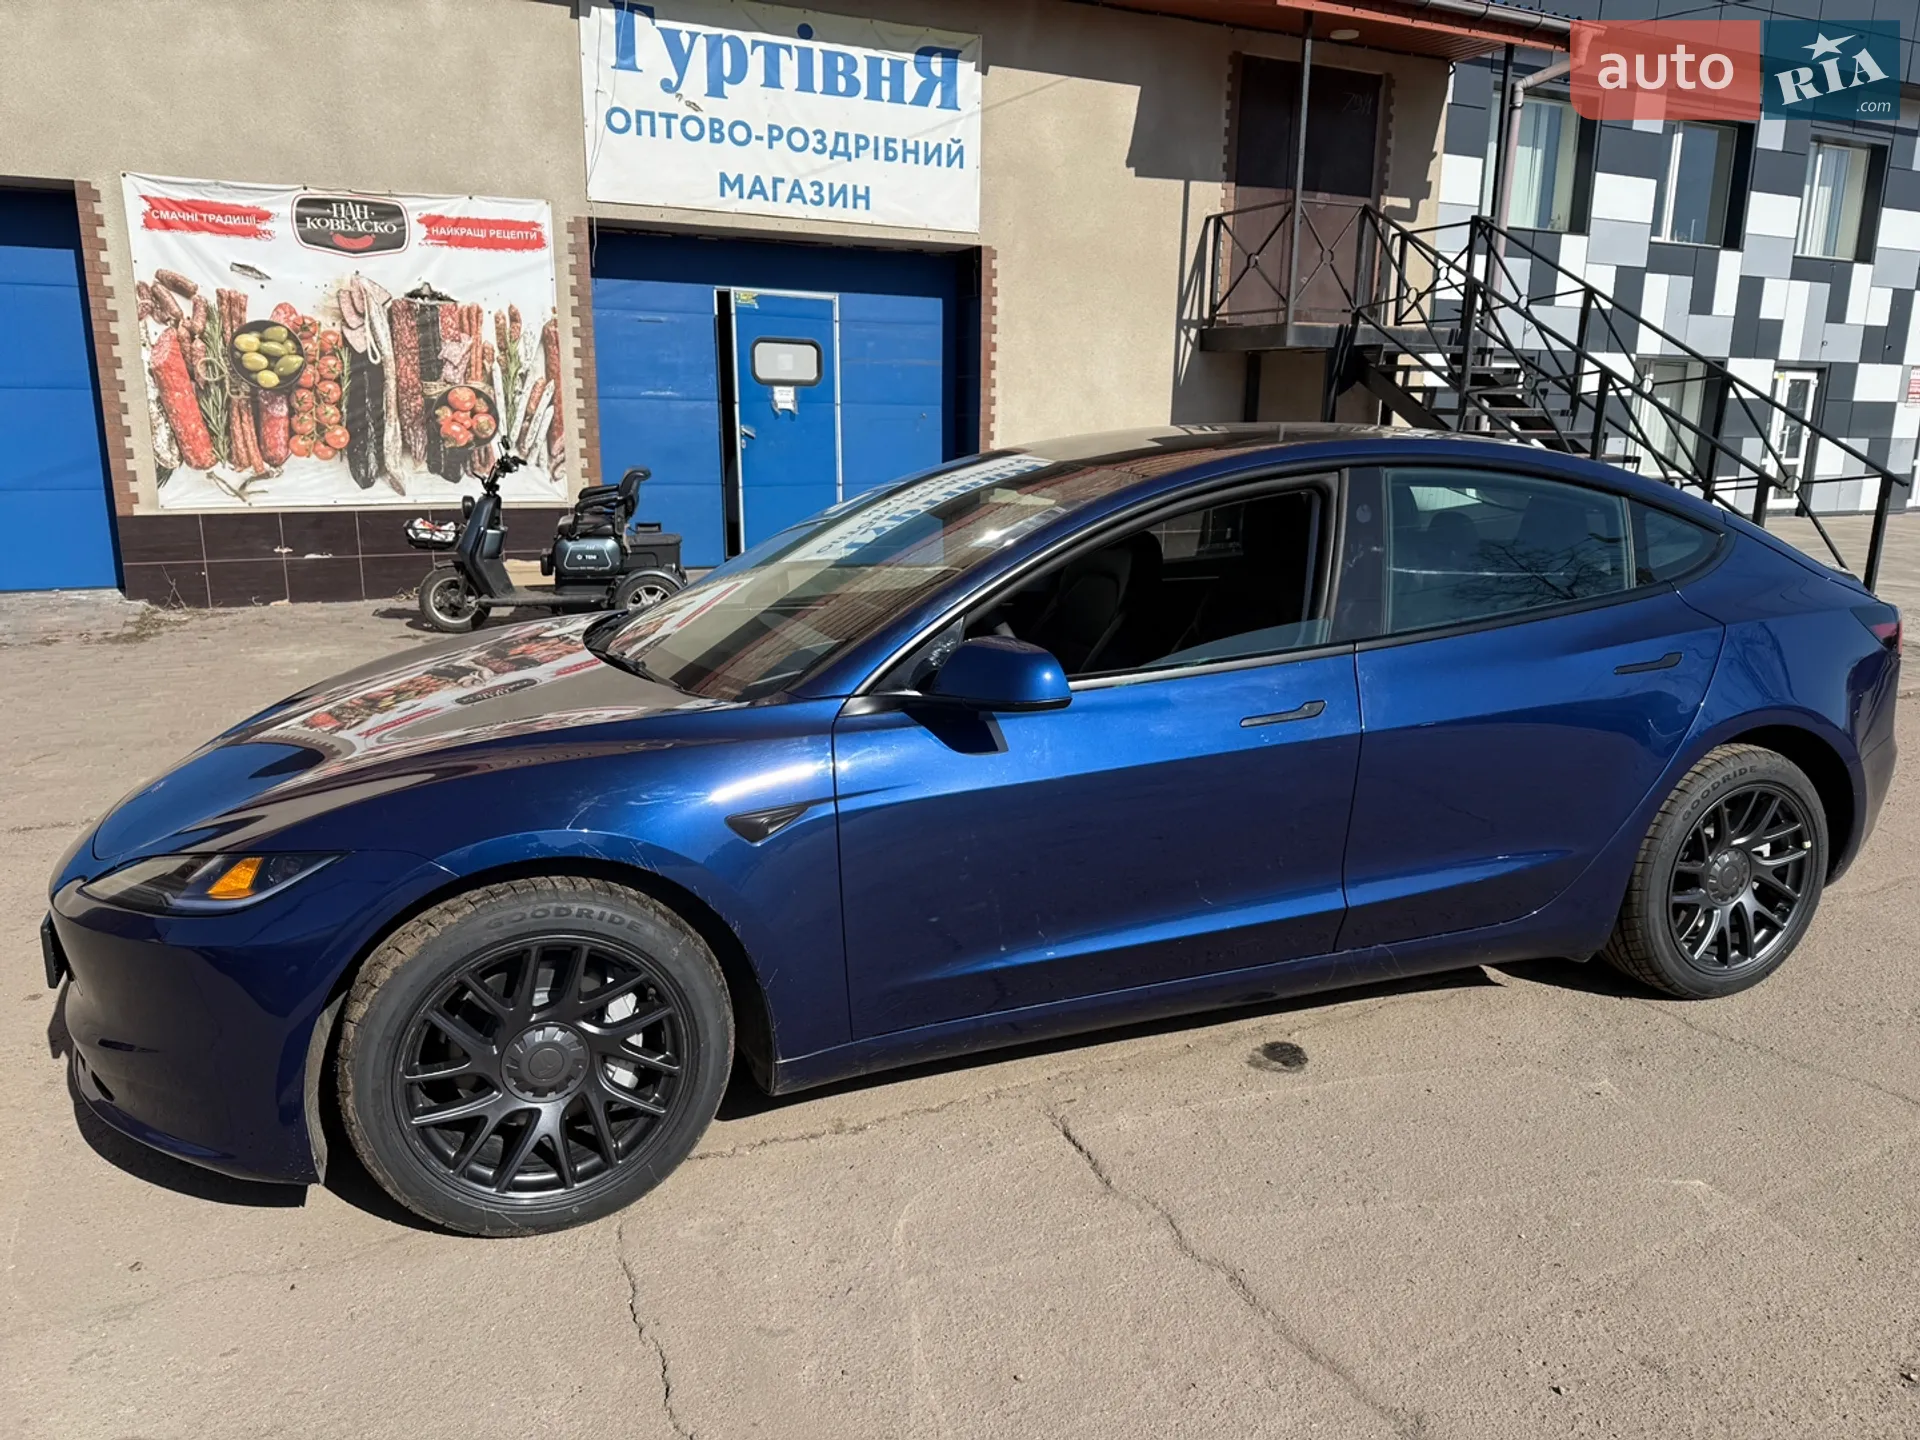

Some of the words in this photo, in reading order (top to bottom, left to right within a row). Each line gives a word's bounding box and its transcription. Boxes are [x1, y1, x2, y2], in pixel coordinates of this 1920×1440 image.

[605, 106, 965, 169] ОПТОВО-РОЗДРІБНИЙ
[719, 172, 871, 211] МАГАЗИН
[151, 209, 198, 222] СМАЧНІ
[331, 201, 370, 220] ПАН
[305, 217, 398, 234] КОВБАСКО
[431, 225, 487, 238] НАЙКРАЩІ
[489, 229, 538, 240] РЕЦЕПТИ
[1682, 765, 1757, 823] GOODRIDE
[484, 906, 644, 932] GOODRIDE
